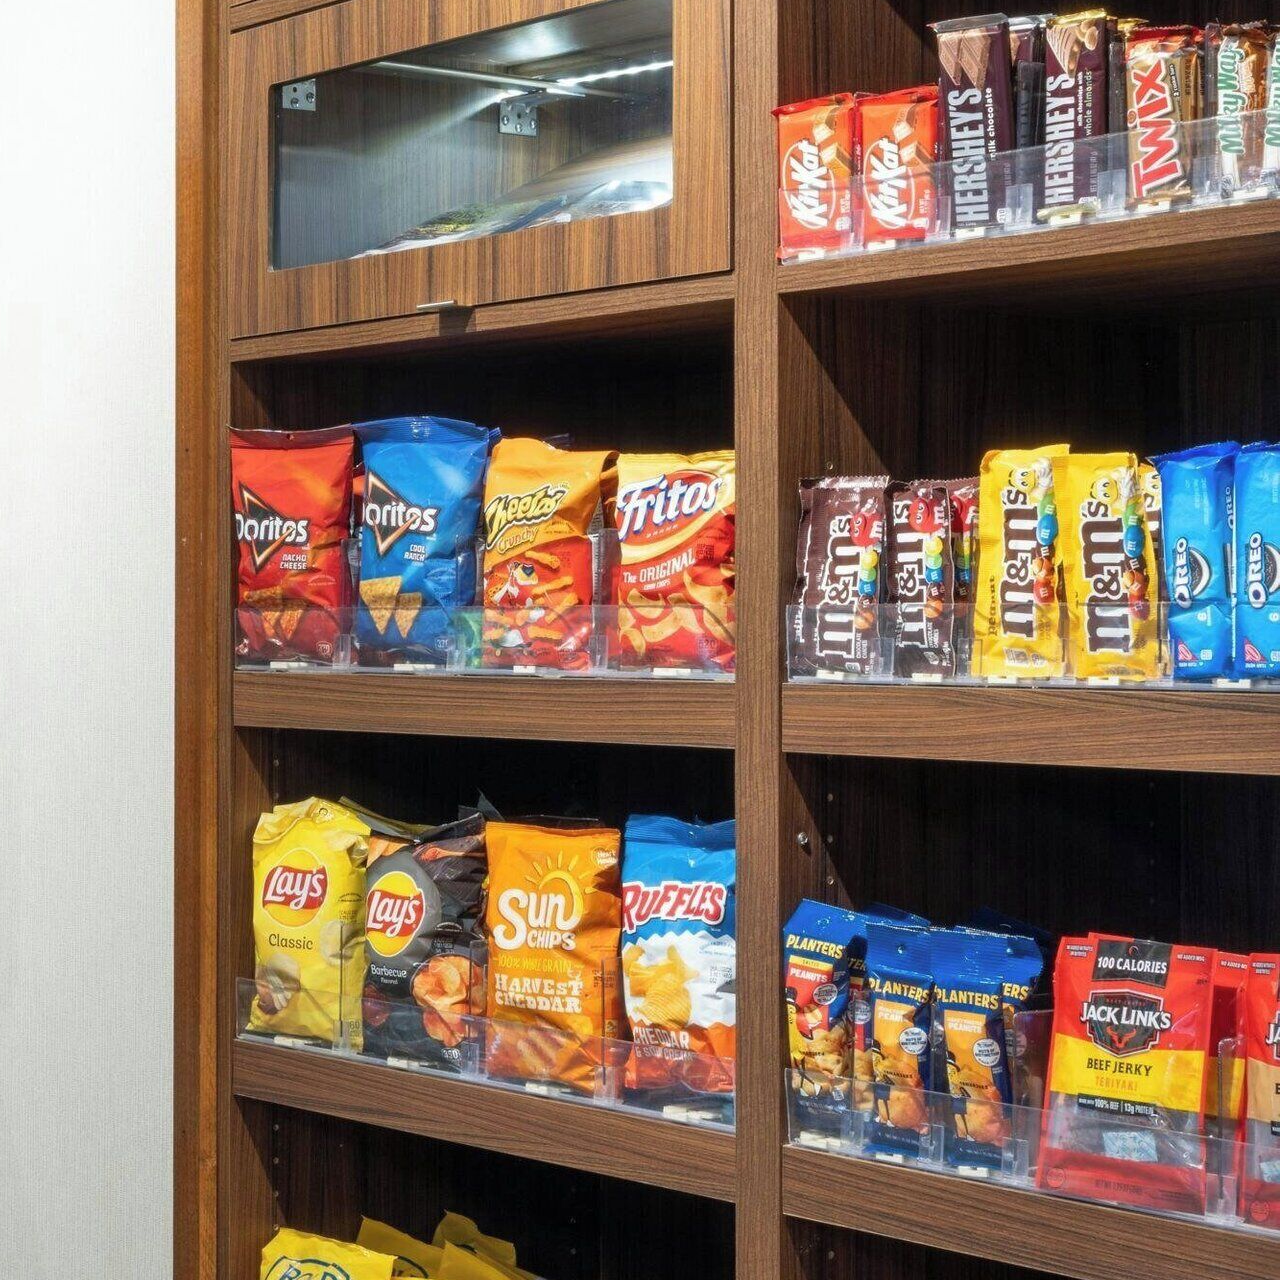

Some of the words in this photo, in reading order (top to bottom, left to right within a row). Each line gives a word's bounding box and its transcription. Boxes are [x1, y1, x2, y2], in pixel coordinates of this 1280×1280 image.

[1084, 69, 1093, 112] almonds
[985, 87, 995, 137] chocolate
[1085, 113, 1093, 135] whole
[1046, 73, 1075, 205] HERSHEY'S
[1127, 60, 1180, 198] TWIX
[948, 88, 990, 222] HERSHEY'S
[617, 474, 723, 540] Fritos
[236, 513, 308, 543] Doritos
[498, 527, 539, 552] Crunchy
[282, 554, 307, 562] NACHO
[404, 551, 425, 561] RANCH
[410, 544, 426, 553] COOL
[279, 561, 307, 570] CHEESE
[639, 548, 697, 582] ORIGINAL
[1175, 537, 1191, 608] OREO
[1249, 532, 1267, 608] OREO
[265, 865, 324, 909] Lay's
[367, 891, 419, 938] Lay's
[493, 888, 582, 950] Sun
[622, 882, 724, 931] RUFFLES
[268, 933, 313, 950] Classic
[526, 929, 576, 951] CHIPS
[785, 933, 843, 960] PLANTERS
[371, 964, 407, 979] Barbecue
[498, 955, 520, 968] 100%
[1097, 956, 1115, 970] 100
[1117, 958, 1168, 974] CALORIES
[494, 973, 584, 996] HARVEST
[790, 968, 828, 983] PEANUTS
[495, 991, 582, 1014] CHEDDAR
[869, 978, 929, 1004] PLANTERS
[934, 983, 999, 1009] PLANTERS
[949, 1021, 982, 1033] PEANUTS
[1081, 1002, 1118, 1025] JACK
[1122, 1007, 1172, 1030] LINK'S
[633, 1026, 690, 1049] CHEDDAR
[1086, 1058, 1111, 1071] BEEF
[1112, 1061, 1153, 1077] JERKY
